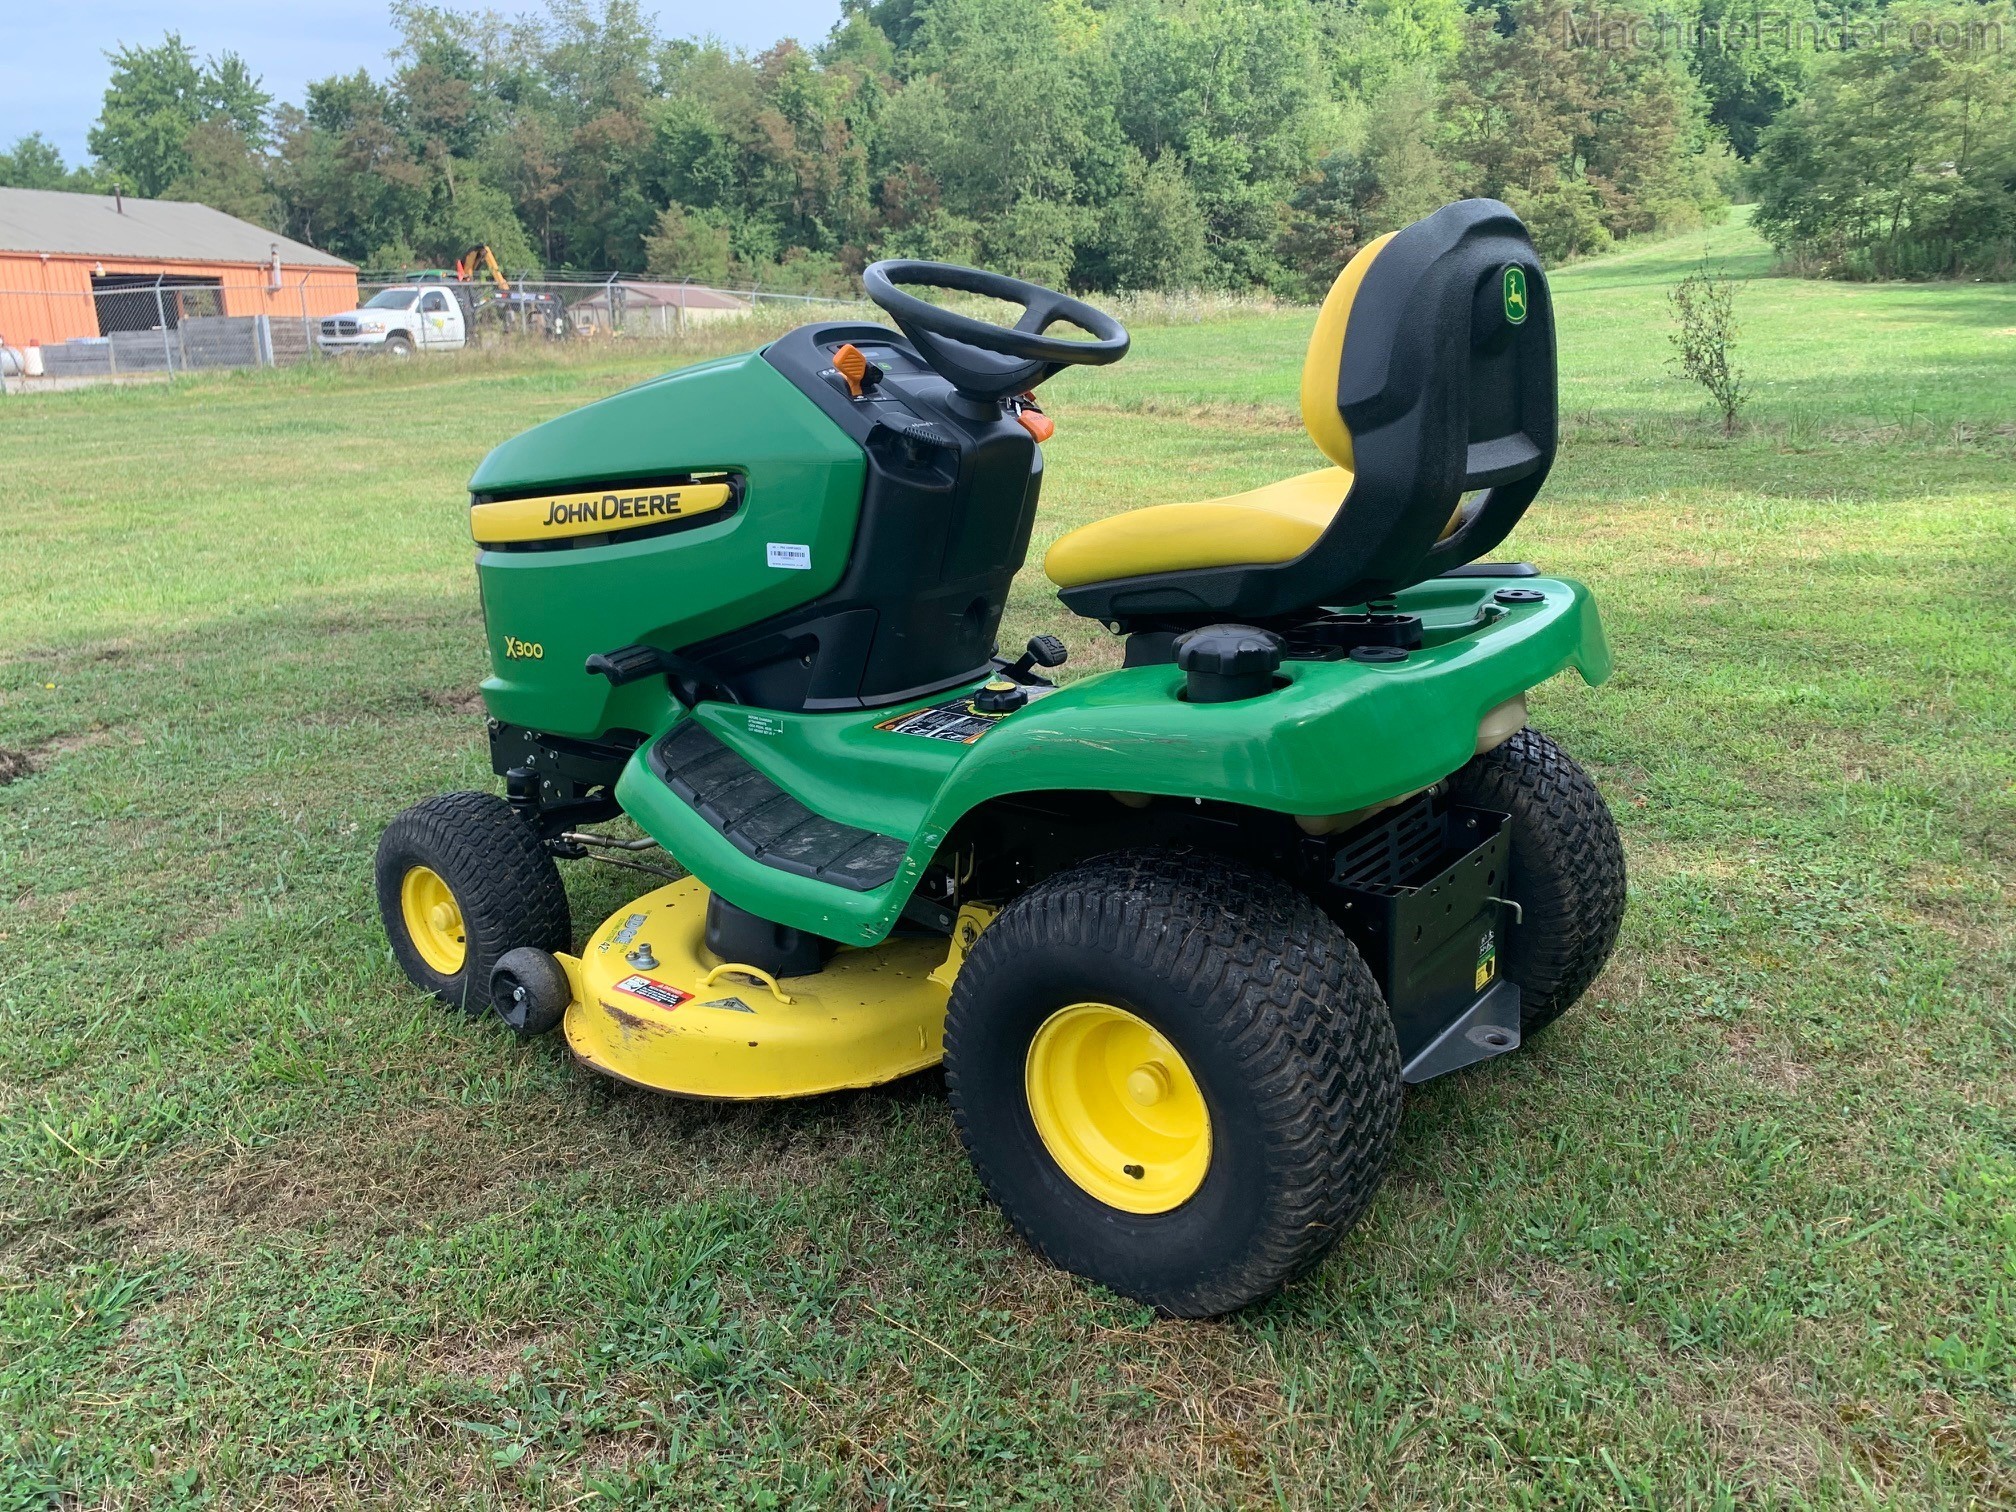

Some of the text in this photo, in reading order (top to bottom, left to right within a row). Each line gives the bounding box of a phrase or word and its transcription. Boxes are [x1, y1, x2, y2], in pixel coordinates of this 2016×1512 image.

[543, 492, 682, 526] JOHN DEERE
[504, 635, 544, 659] X300
